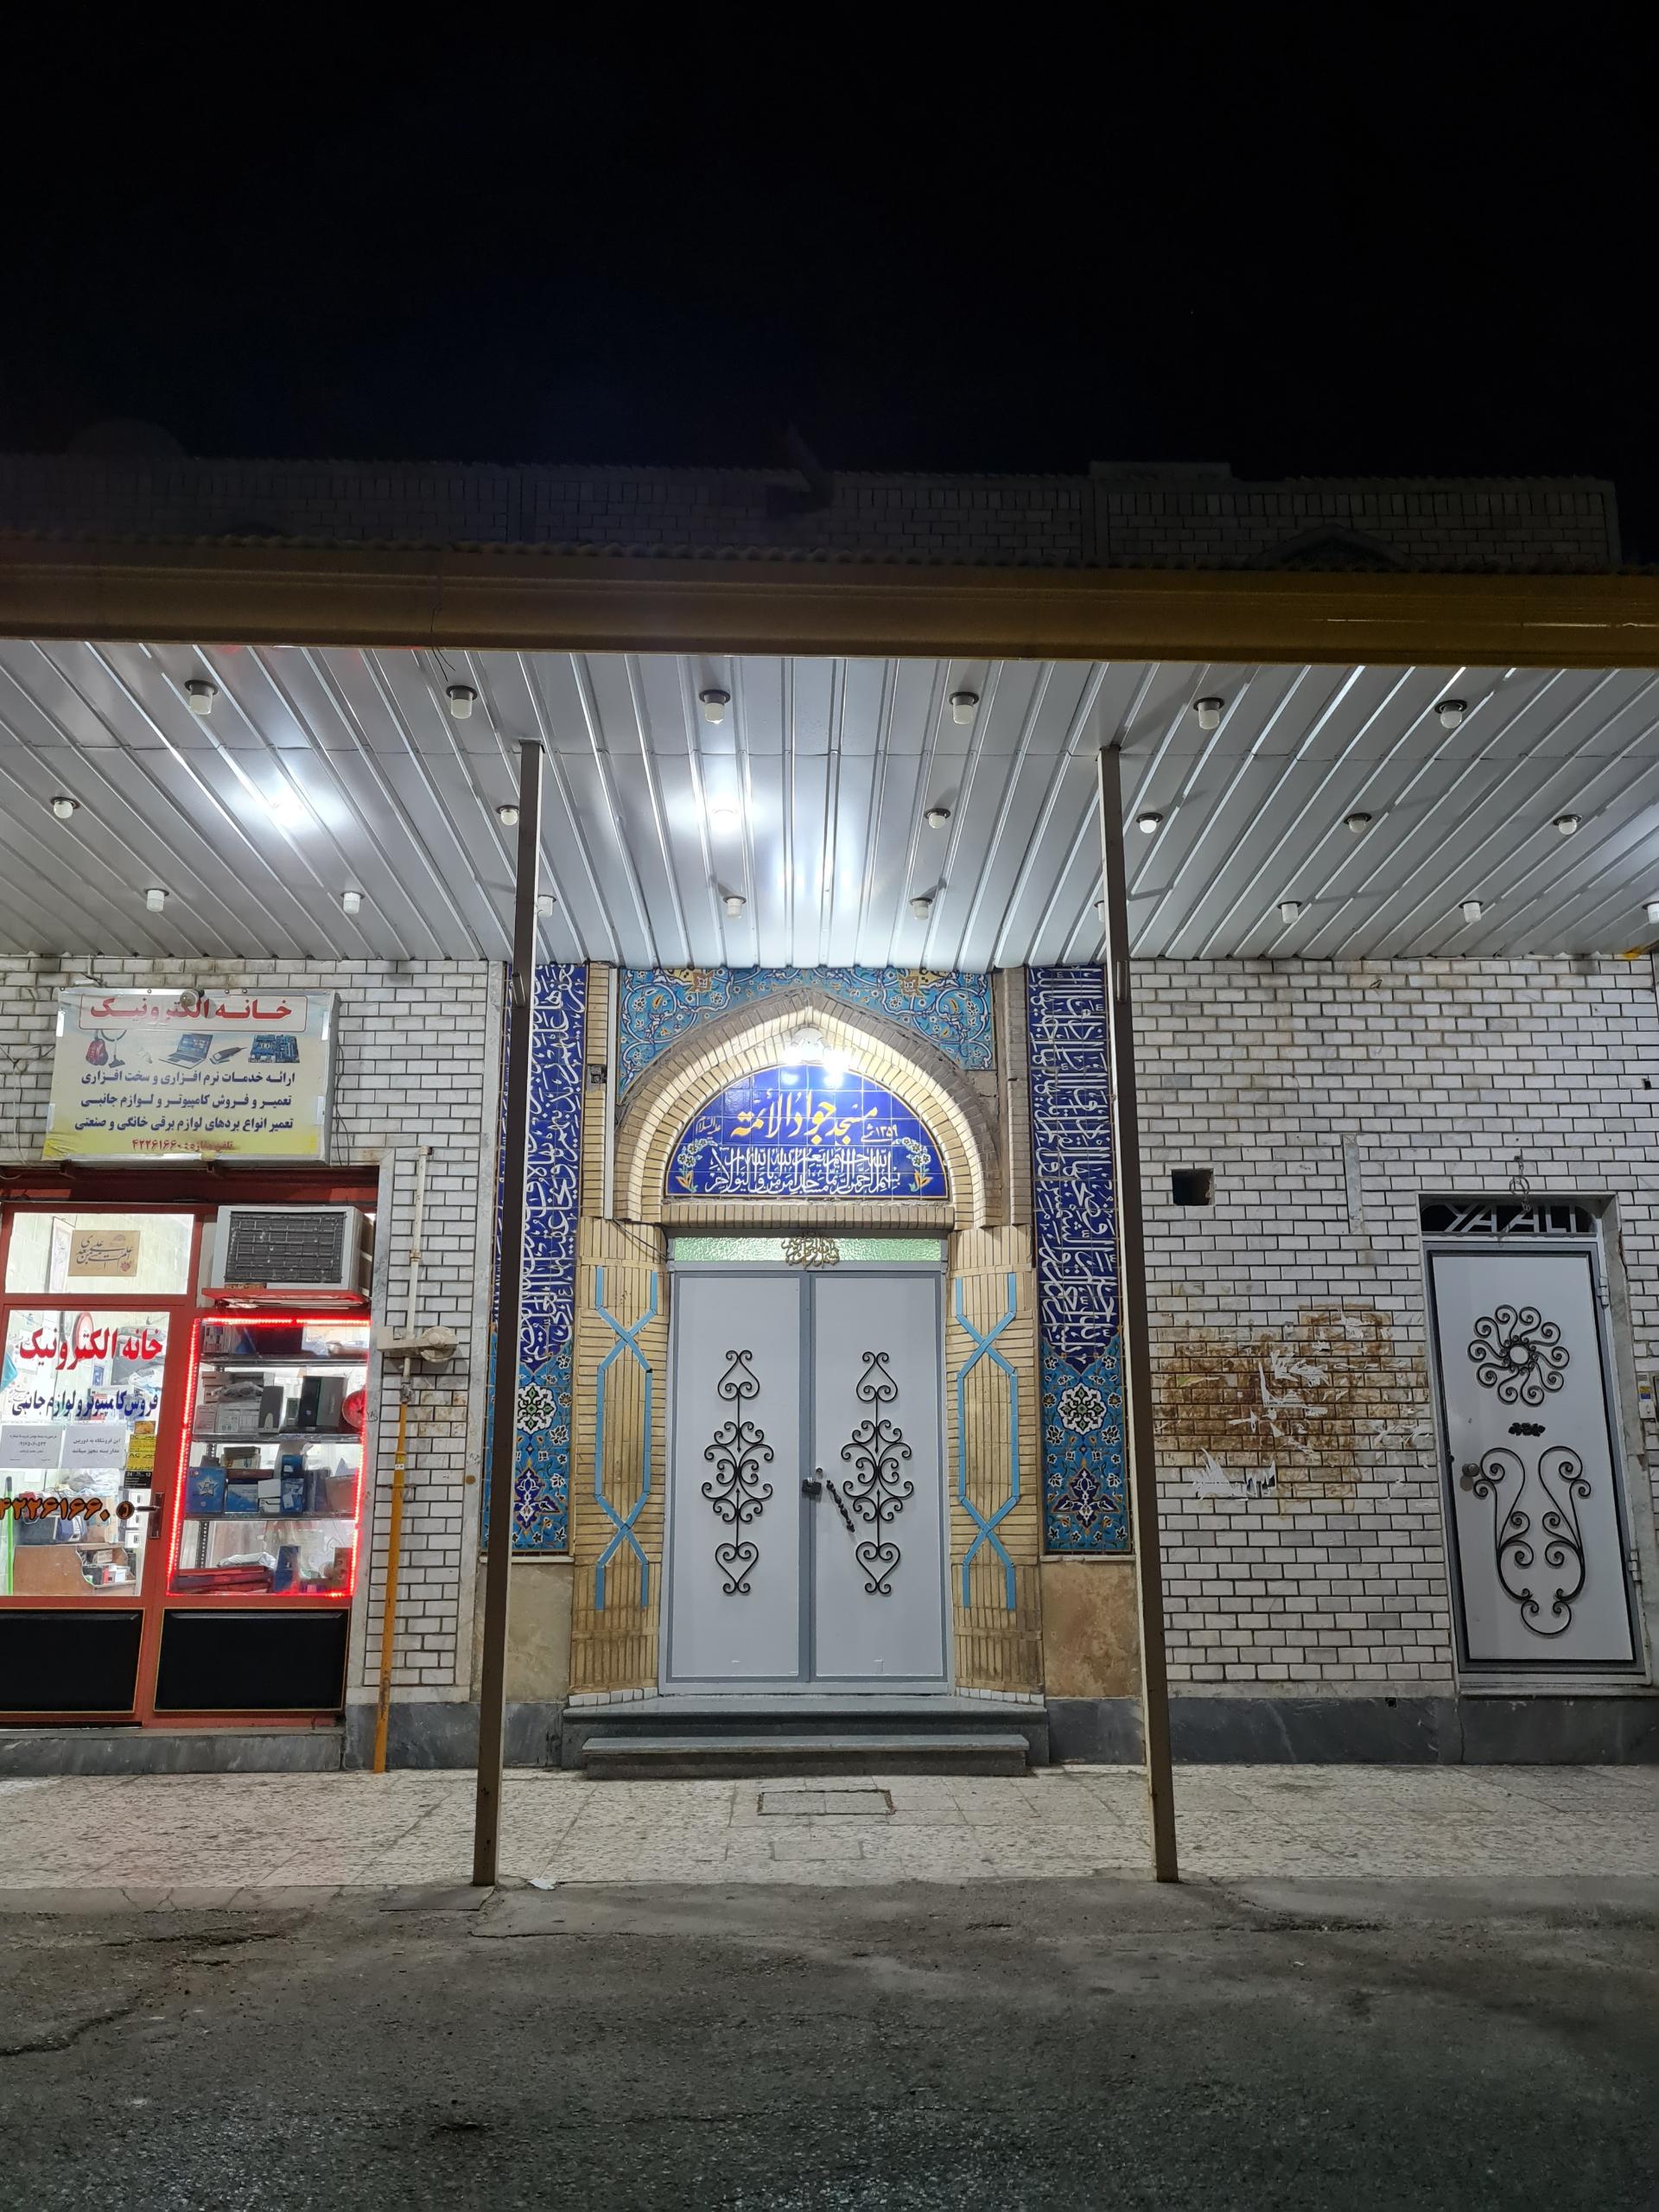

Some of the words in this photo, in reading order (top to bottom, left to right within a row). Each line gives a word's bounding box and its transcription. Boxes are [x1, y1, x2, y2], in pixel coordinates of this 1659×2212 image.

[90, 997, 210, 1026] الکترونیک
[216, 998, 292, 1020] خانه
[81, 1070, 123, 1084] افزاری
[124, 1071, 149, 1082] سخت
[152, 1075, 158, 1084] و
[161, 1071, 201, 1085] افزاری
[203, 1071, 219, 1085] نرم
[222, 1071, 263, 1083] خدمات
[266, 1071, 295, 1086] ارائه
[80, 1093, 118, 1107] جانبی
[120, 1093, 154, 1108] لوازم
[156, 1098, 162, 1108] و
[164, 1094, 210, 1109] کامپیوتر
[213, 1094, 249, 1109] فروش
[251, 1099, 257, 1109] و
[260, 1095, 292, 1109] تعمیر
[74, 1117, 106, 1130] صنعتی
[108, 1121, 115, 1130] و
[117, 1116, 148, 1130] خانگی
[150, 1116, 175, 1131] برقی
[177, 1116, 202, 1132] لوازم
[205, 1116, 240, 1132] بردهای
[242, 1117, 267, 1132] انواع
[269, 1118, 294, 1132] تعمیر
[825, 1103, 878, 1141] مسجد
[131, 1139, 182, 1151] ۴۲۲۶۱۶۶۰
[1444, 1202, 1497, 1233] YA
[1504, 1203, 1578, 1234] ALI
[19, 1327, 119, 1370] الکترونیک
[122, 1328, 163, 1361] خانه
[12, 1389, 46, 1416] جانبی
[46, 1389, 76, 1417] لوازم
[75, 1400, 82, 1417] و
[82, 1389, 128, 1417] کامپیوتر
[124, 1389, 158, 1417] فروش
